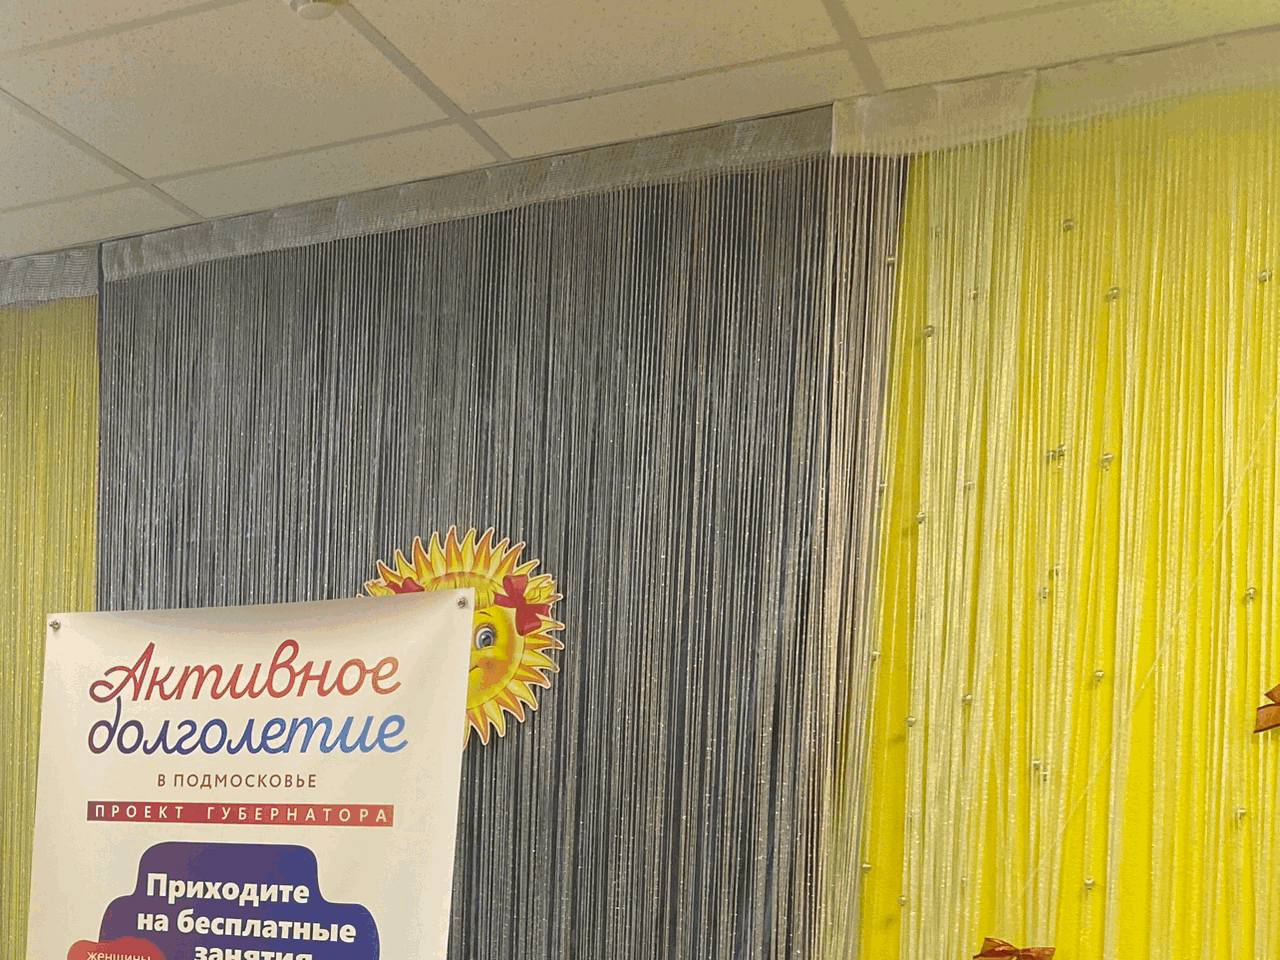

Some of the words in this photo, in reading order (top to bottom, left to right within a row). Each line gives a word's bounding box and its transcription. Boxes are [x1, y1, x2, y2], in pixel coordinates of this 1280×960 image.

[89, 638, 402, 702] Активное
[88, 696, 408, 755] долголетие
[157, 774, 167, 788] В
[173, 774, 317, 790] ПОДМОСКОВЬЕ
[95, 804, 184, 819] ПРОЕКТ
[206, 806, 388, 823] ГУБЕРНАТОРА
[146, 872, 310, 906] Приходите
[136, 910, 169, 932] на
[176, 910, 357, 943] бесплатные
